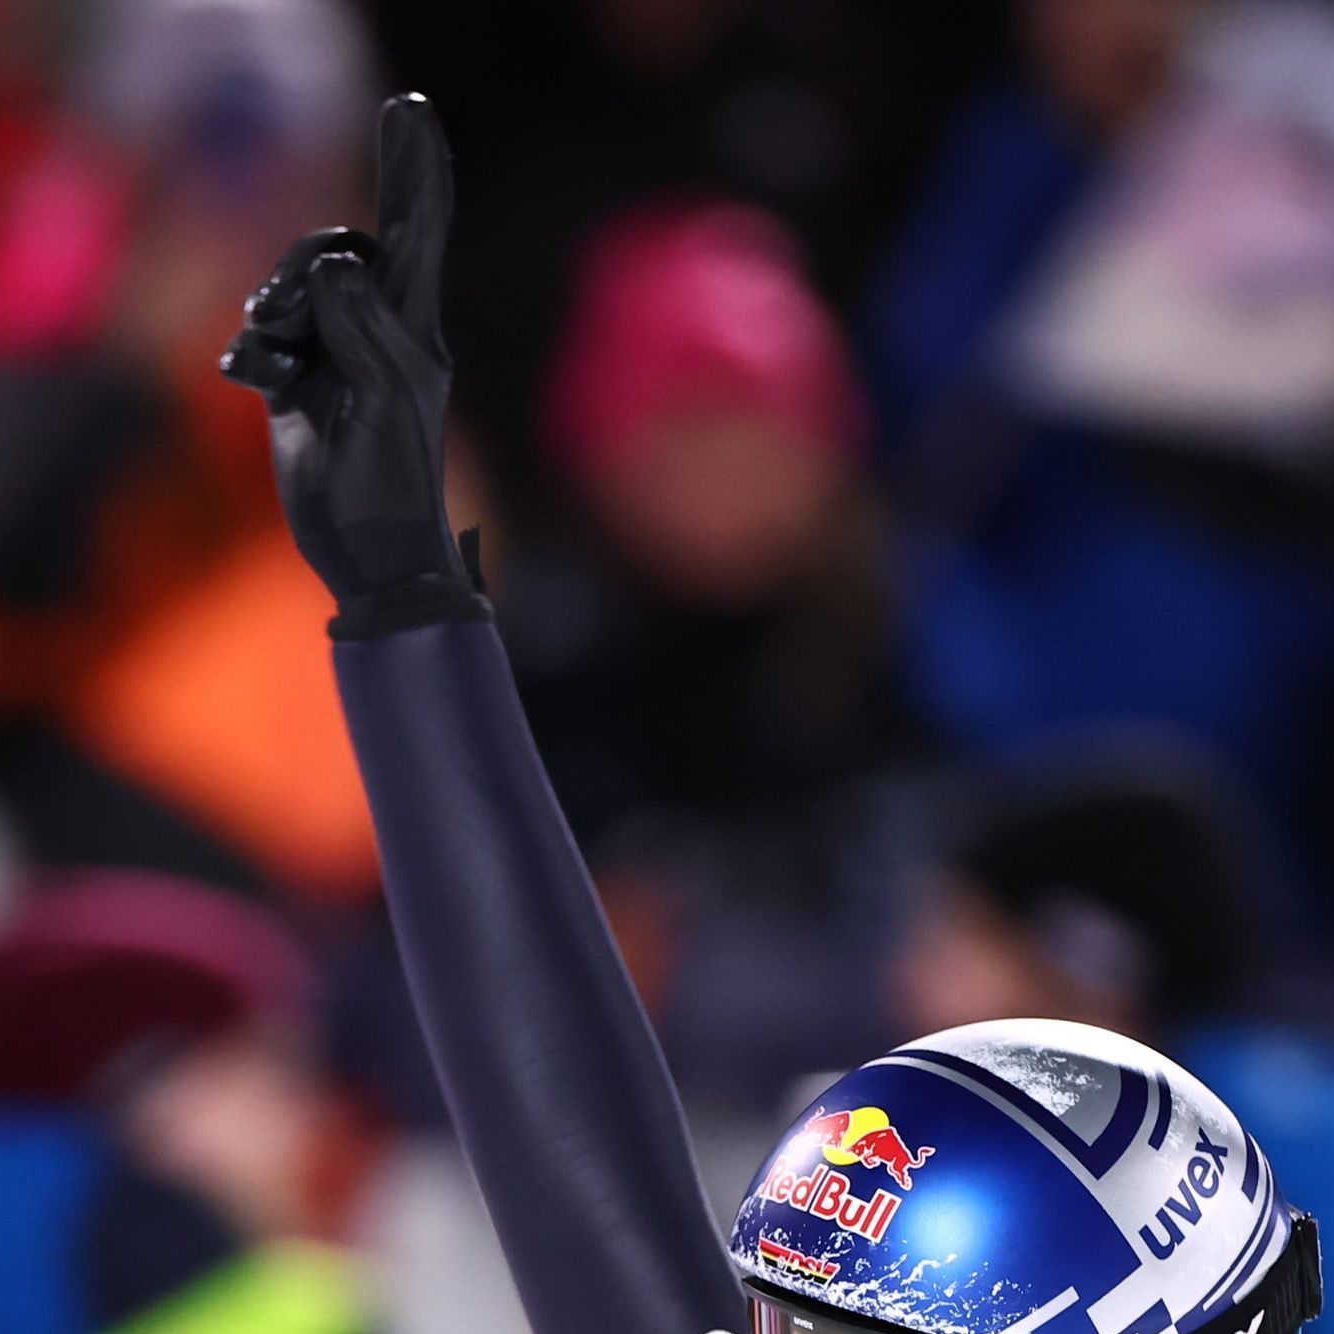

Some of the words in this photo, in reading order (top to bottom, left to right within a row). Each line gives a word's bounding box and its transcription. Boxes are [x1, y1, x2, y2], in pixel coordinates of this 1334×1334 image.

[761, 1155, 828, 1211] Red
[812, 1172, 899, 1242] Bull
[1137, 1126, 1229, 1261] uvex
[793, 1315, 814, 1331] uvex
